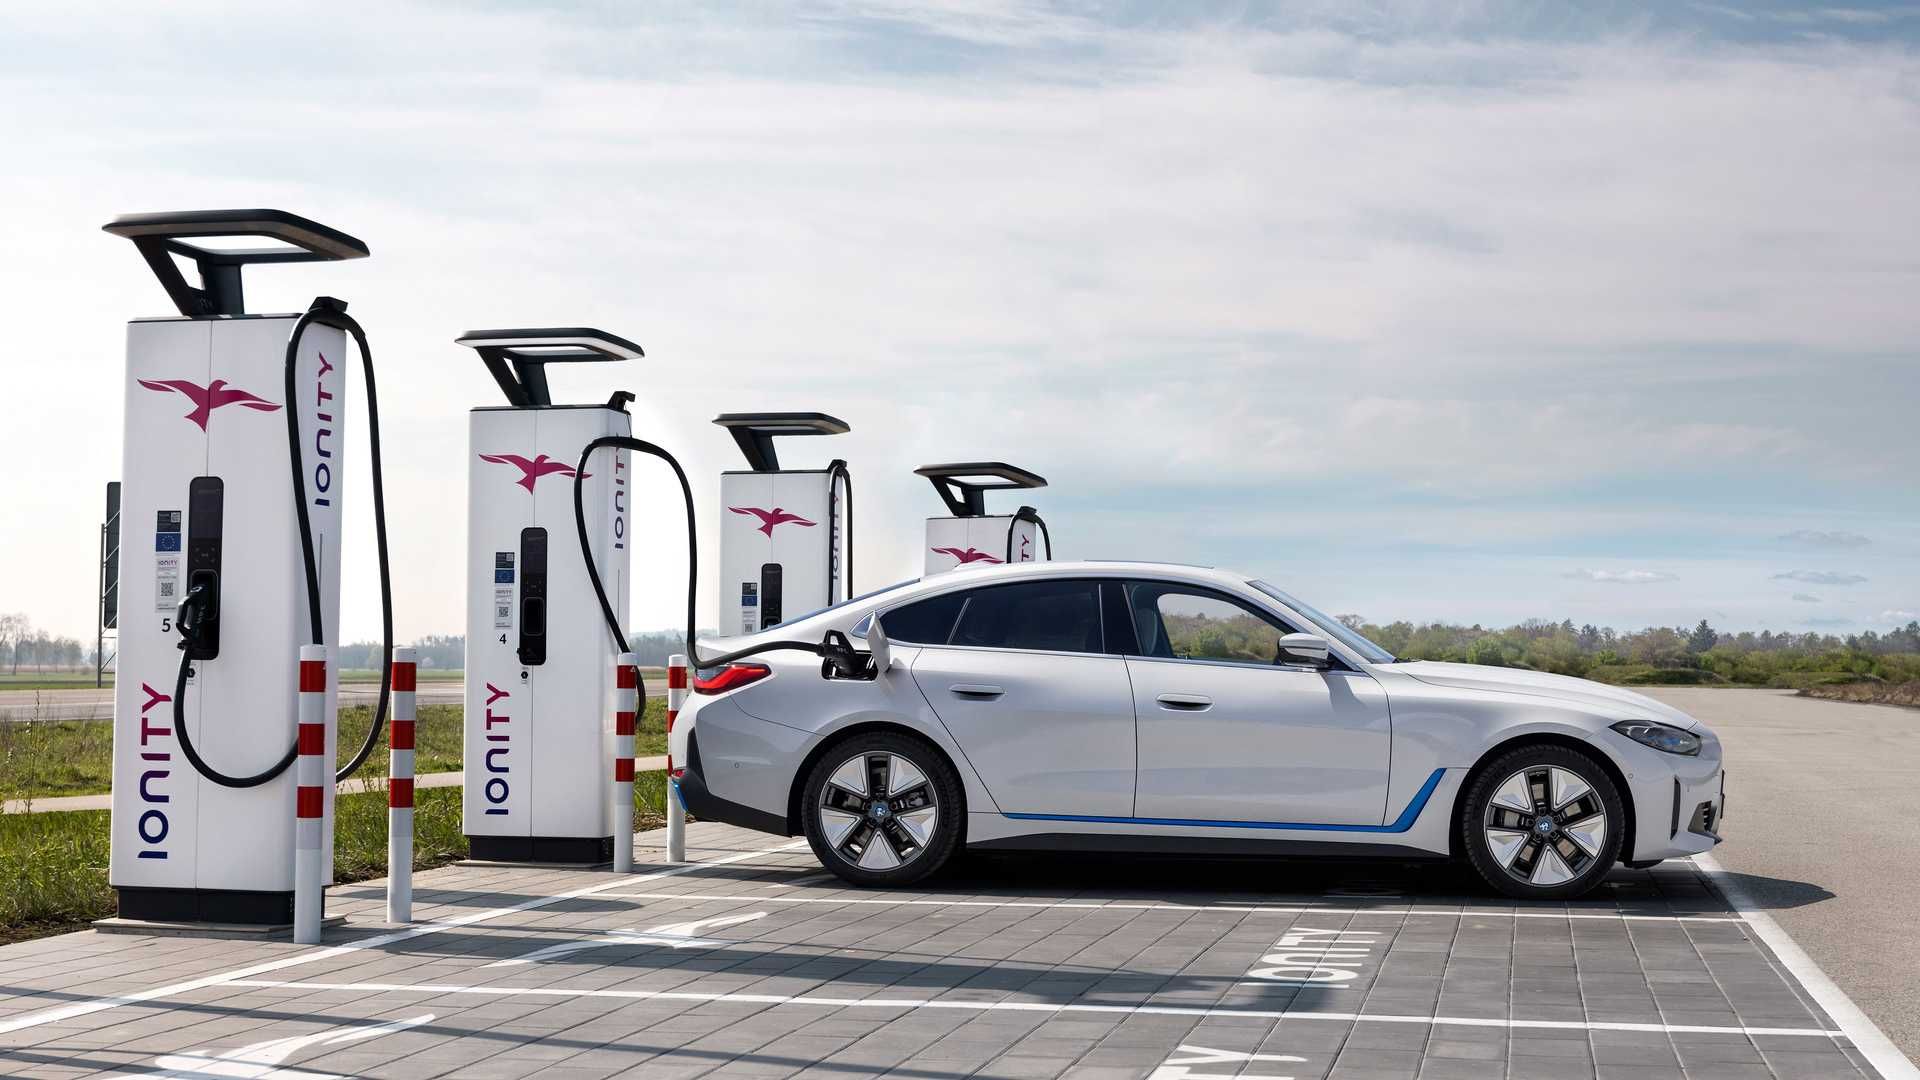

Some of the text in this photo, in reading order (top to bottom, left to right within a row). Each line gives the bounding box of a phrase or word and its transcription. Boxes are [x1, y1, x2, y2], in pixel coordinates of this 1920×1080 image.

[315, 351, 334, 507] IONITY
[161, 618, 171, 633] 5
[499, 633, 507, 645] 4
[137, 682, 172, 859] IONITY
[485, 682, 511, 815] IONITY
[1238, 927, 1384, 988] IONITY
